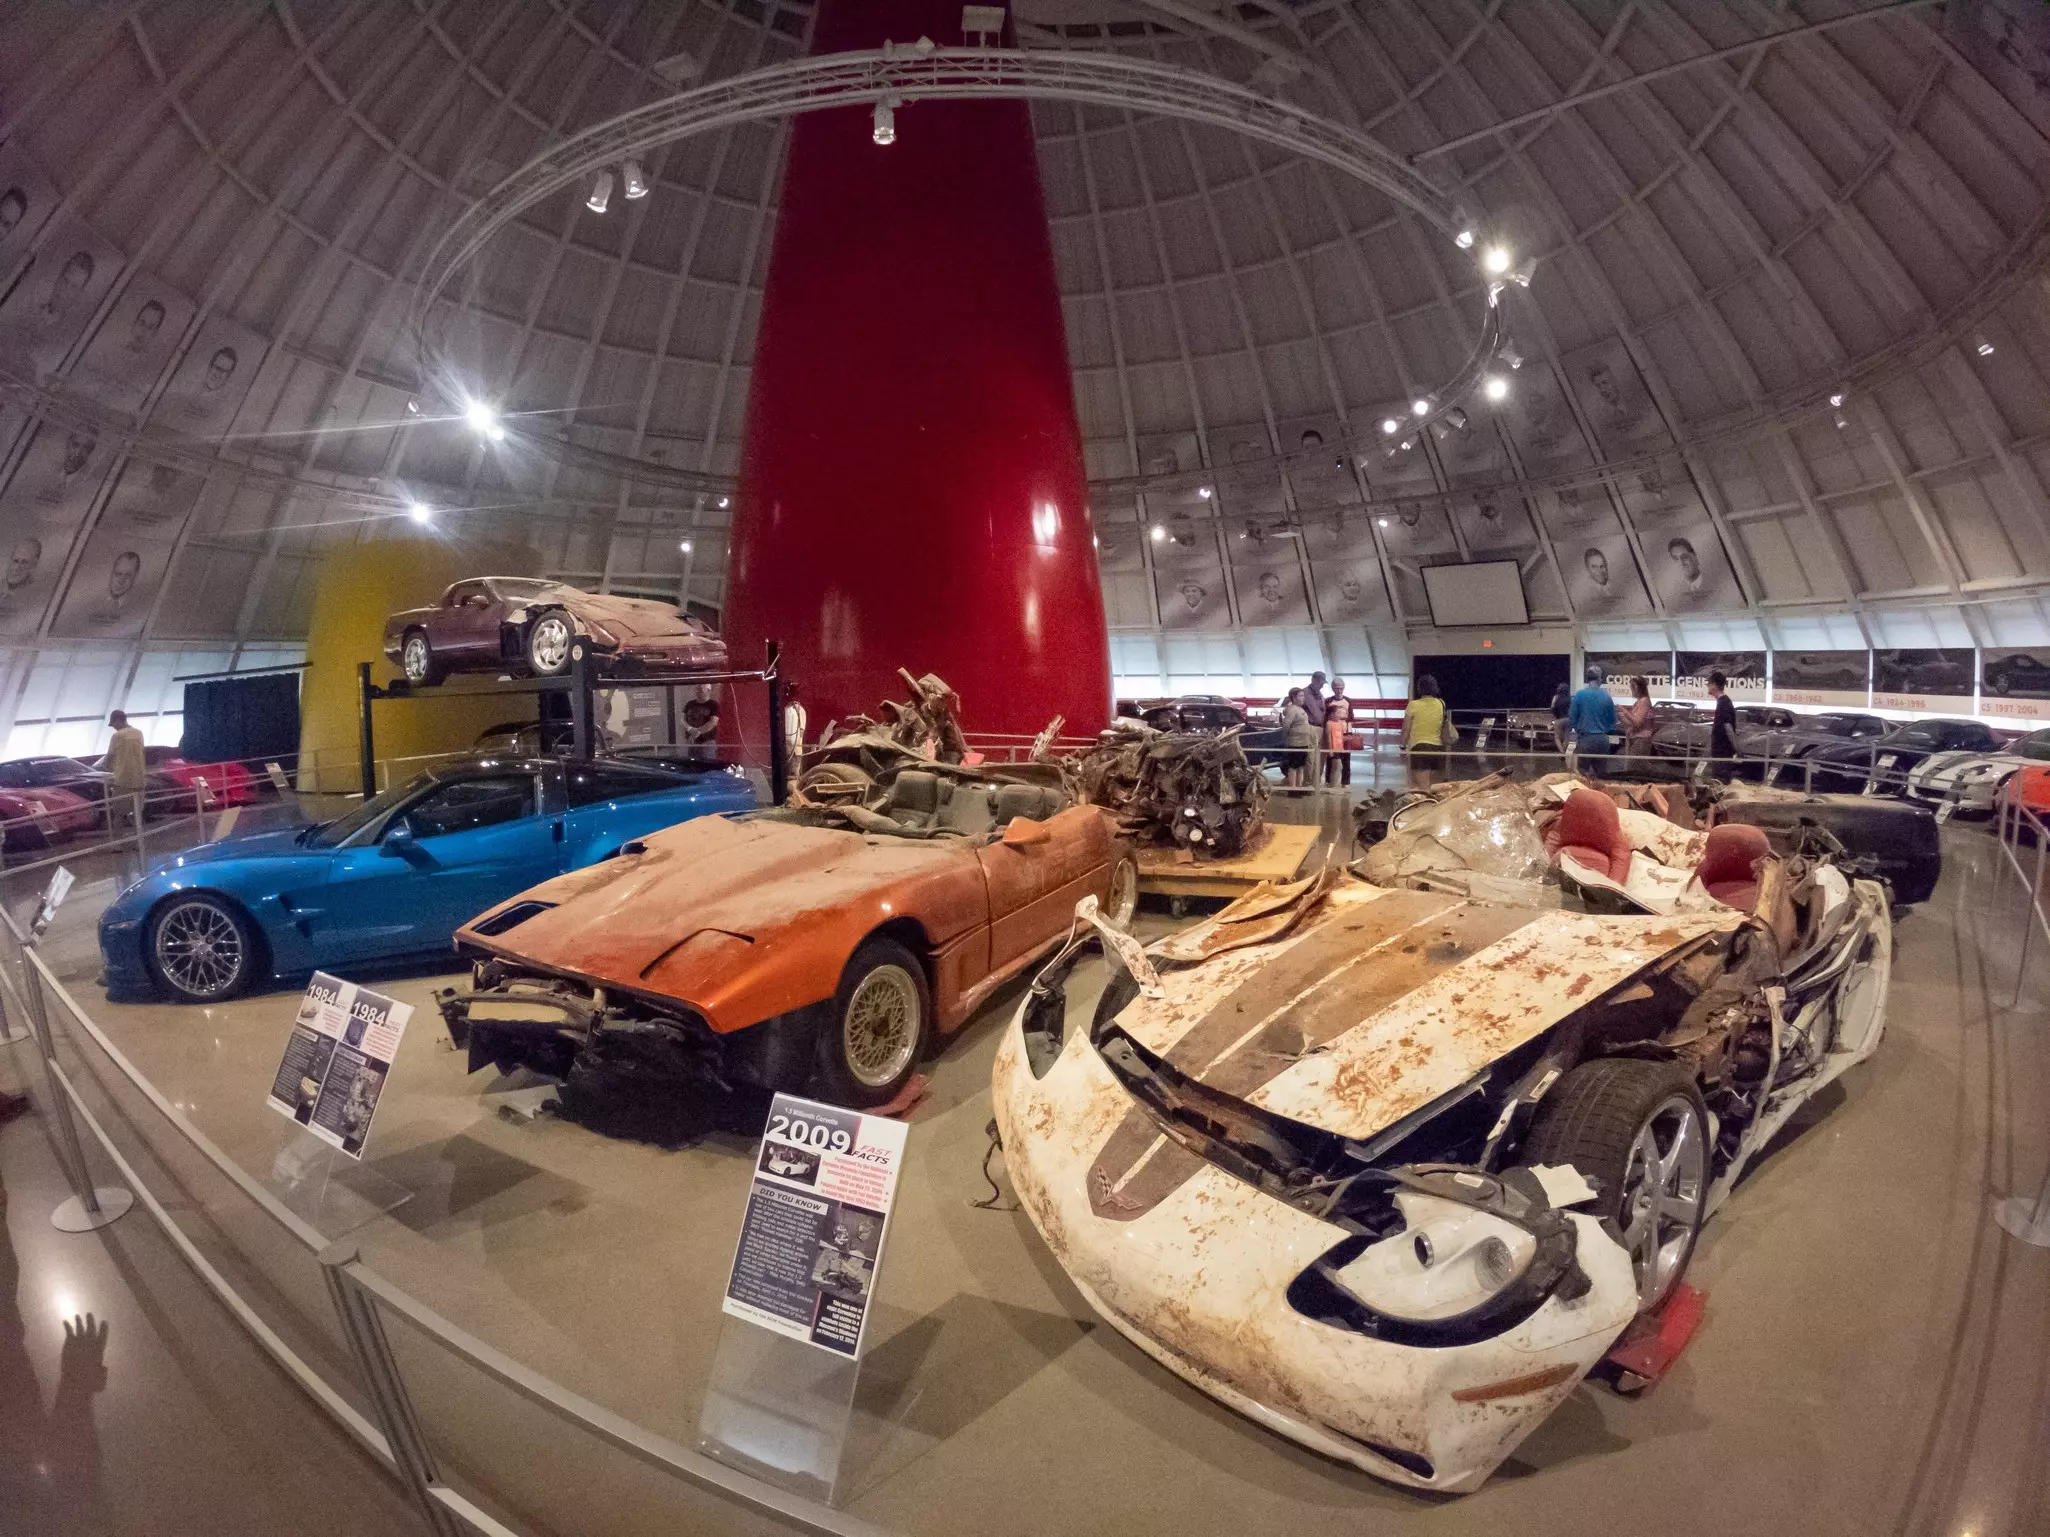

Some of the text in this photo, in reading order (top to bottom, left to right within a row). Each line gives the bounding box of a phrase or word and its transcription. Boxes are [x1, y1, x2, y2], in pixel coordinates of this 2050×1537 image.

[1606, 674, 1766, 689] CORTTE GENETIONS
[1981, 703, 2038, 716] C5 1997-2004
[308, 984, 337, 1006] 1984
[352, 1001, 386, 1026] 1984
[815, 1114, 838, 1125] Corvette
[767, 1113, 852, 1155] 2009
[851, 1149, 889, 1165] FACTS
[860, 1144, 891, 1157] FAST
[759, 1187, 821, 1210] DID YOU KNOW
